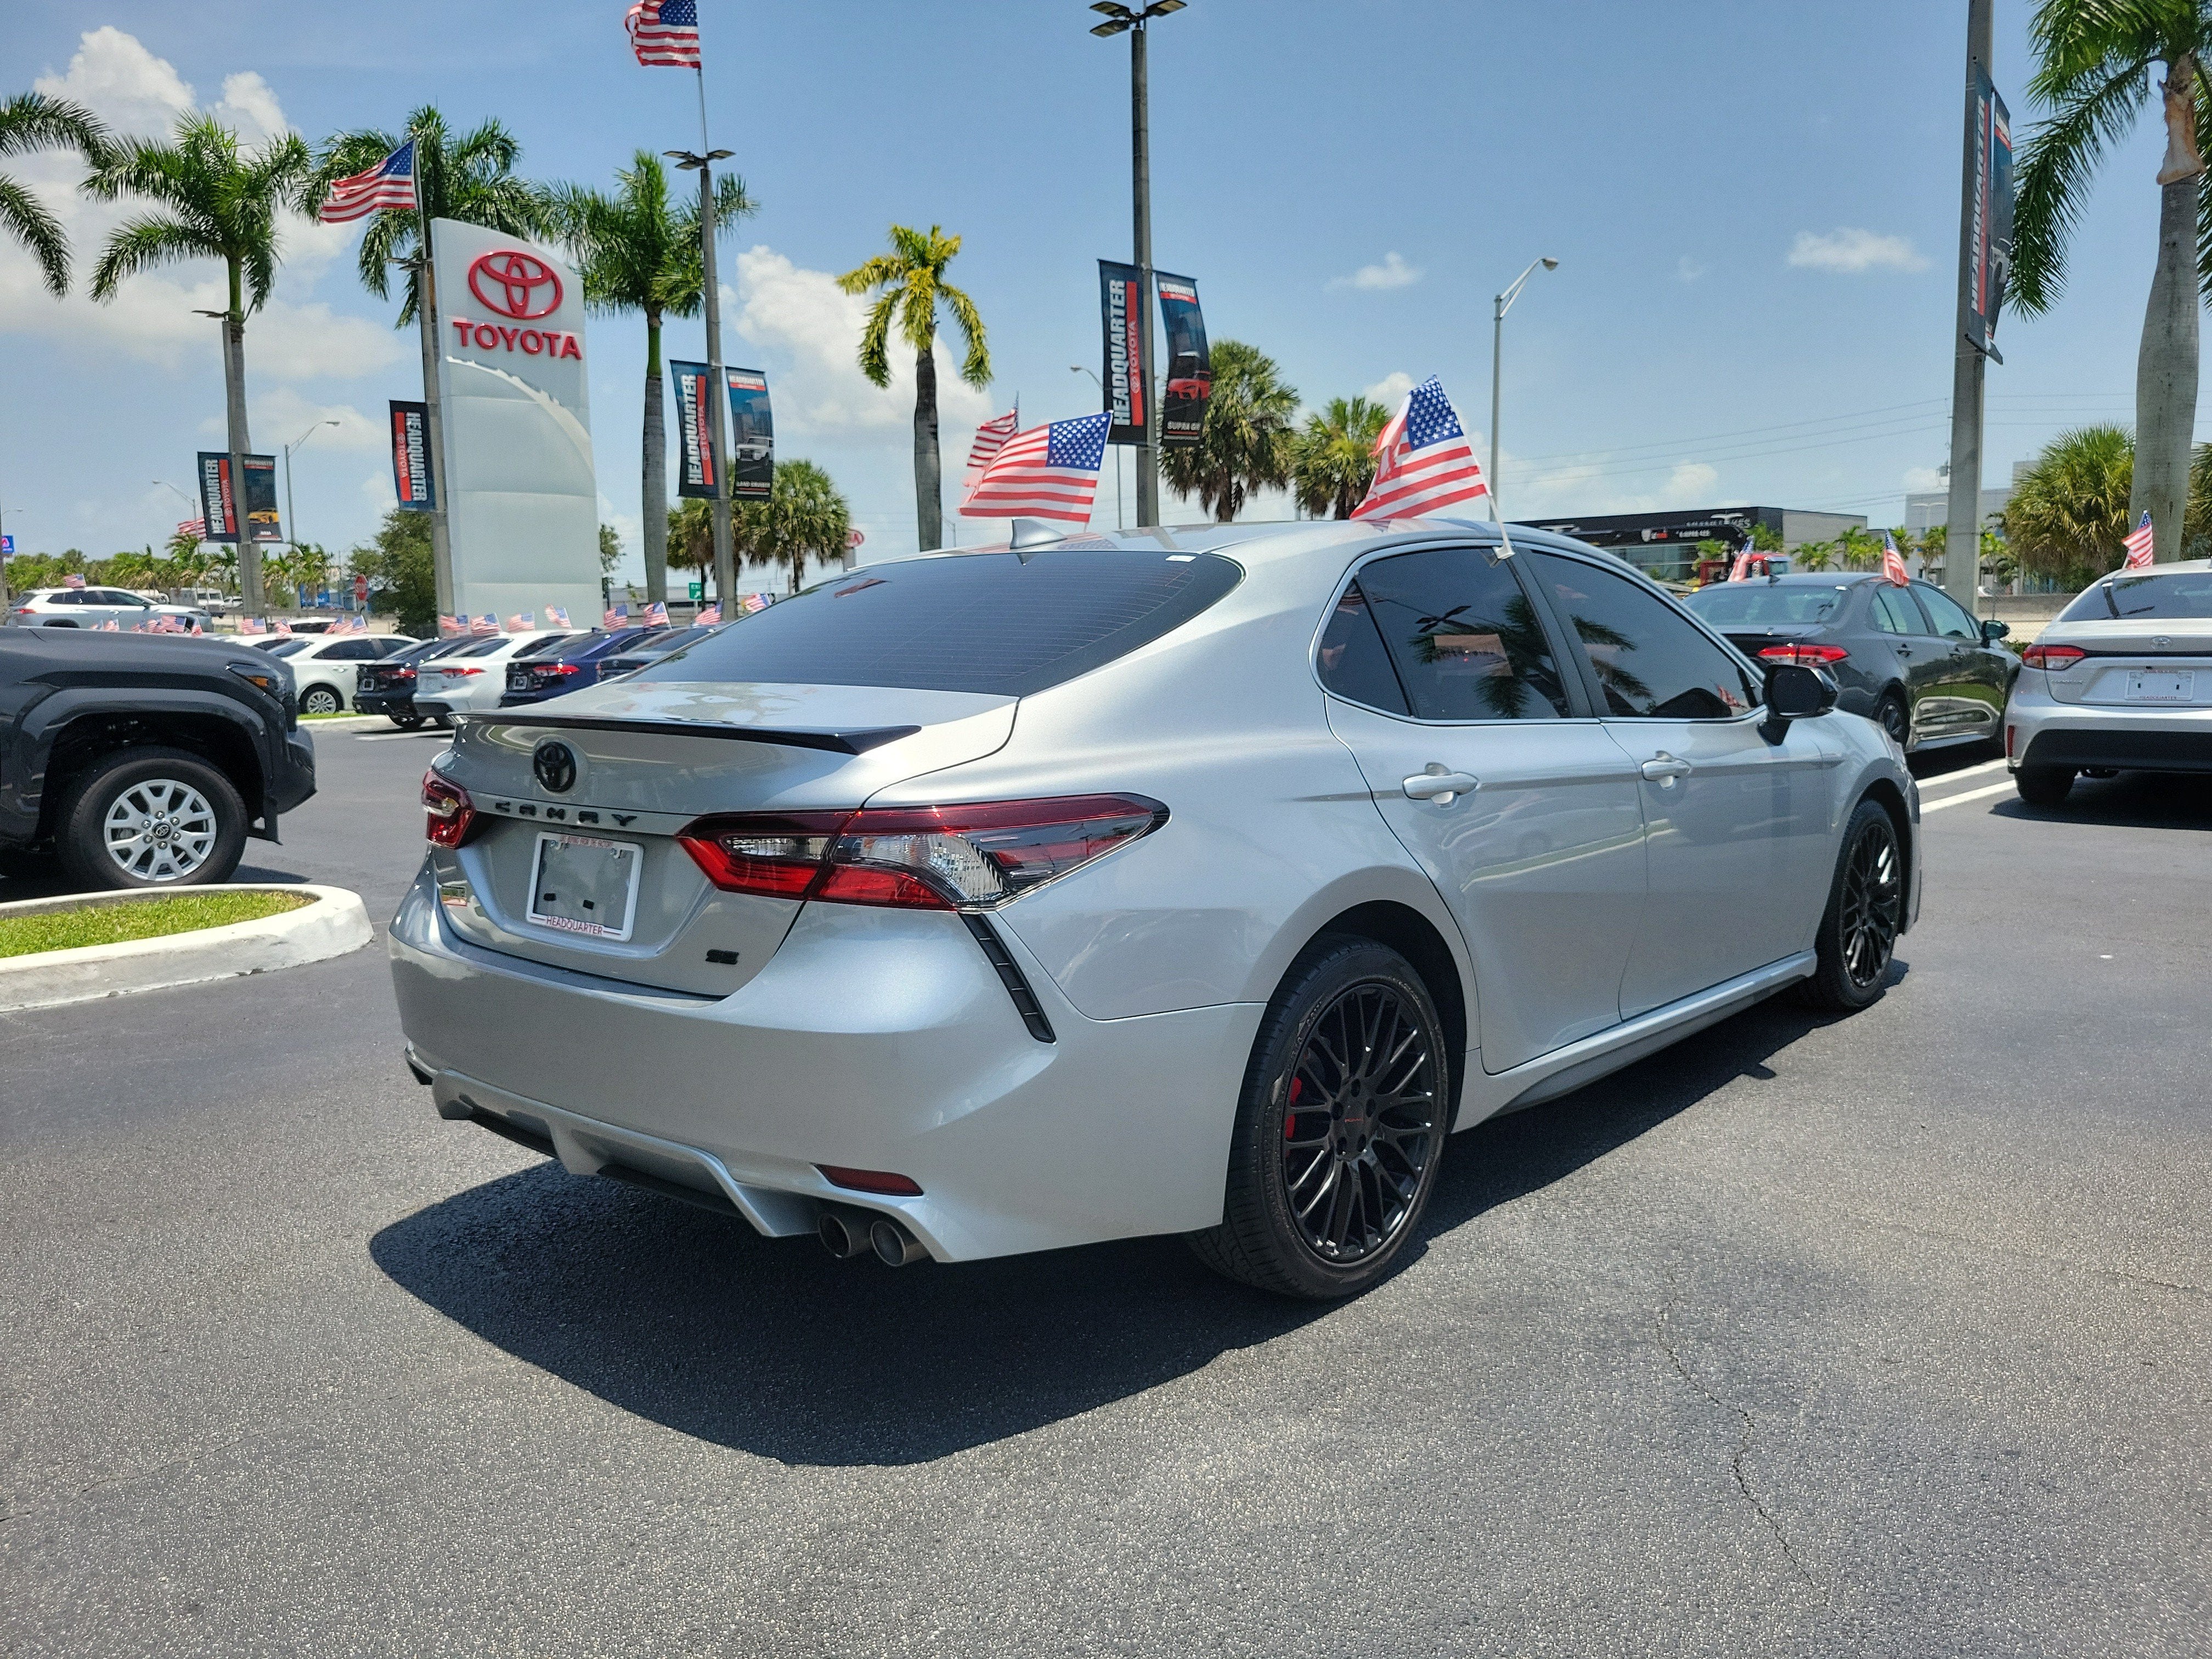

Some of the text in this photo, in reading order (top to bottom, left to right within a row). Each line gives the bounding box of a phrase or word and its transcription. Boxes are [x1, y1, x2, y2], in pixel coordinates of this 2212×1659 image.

[1971, 94, 1985, 312] HEADQUARTER
[453, 321, 583, 360] TOYOTA
[1109, 279, 1131, 426] HEADQUARTER
[1127, 320, 1139, 375] TOYOTA
[681, 375, 703, 485] HEADQUARTER
[697, 405, 709, 445] TOYOTA
[397, 443, 408, 478] TOYOTA
[405, 412, 427, 501] HEADQUARTER
[205, 459, 226, 534] HEADQUARTER
[221, 479, 233, 507] TOYOTA
[495, 801, 637, 826] CAMRY
[546, 916, 603, 935] HEADQUARTER
